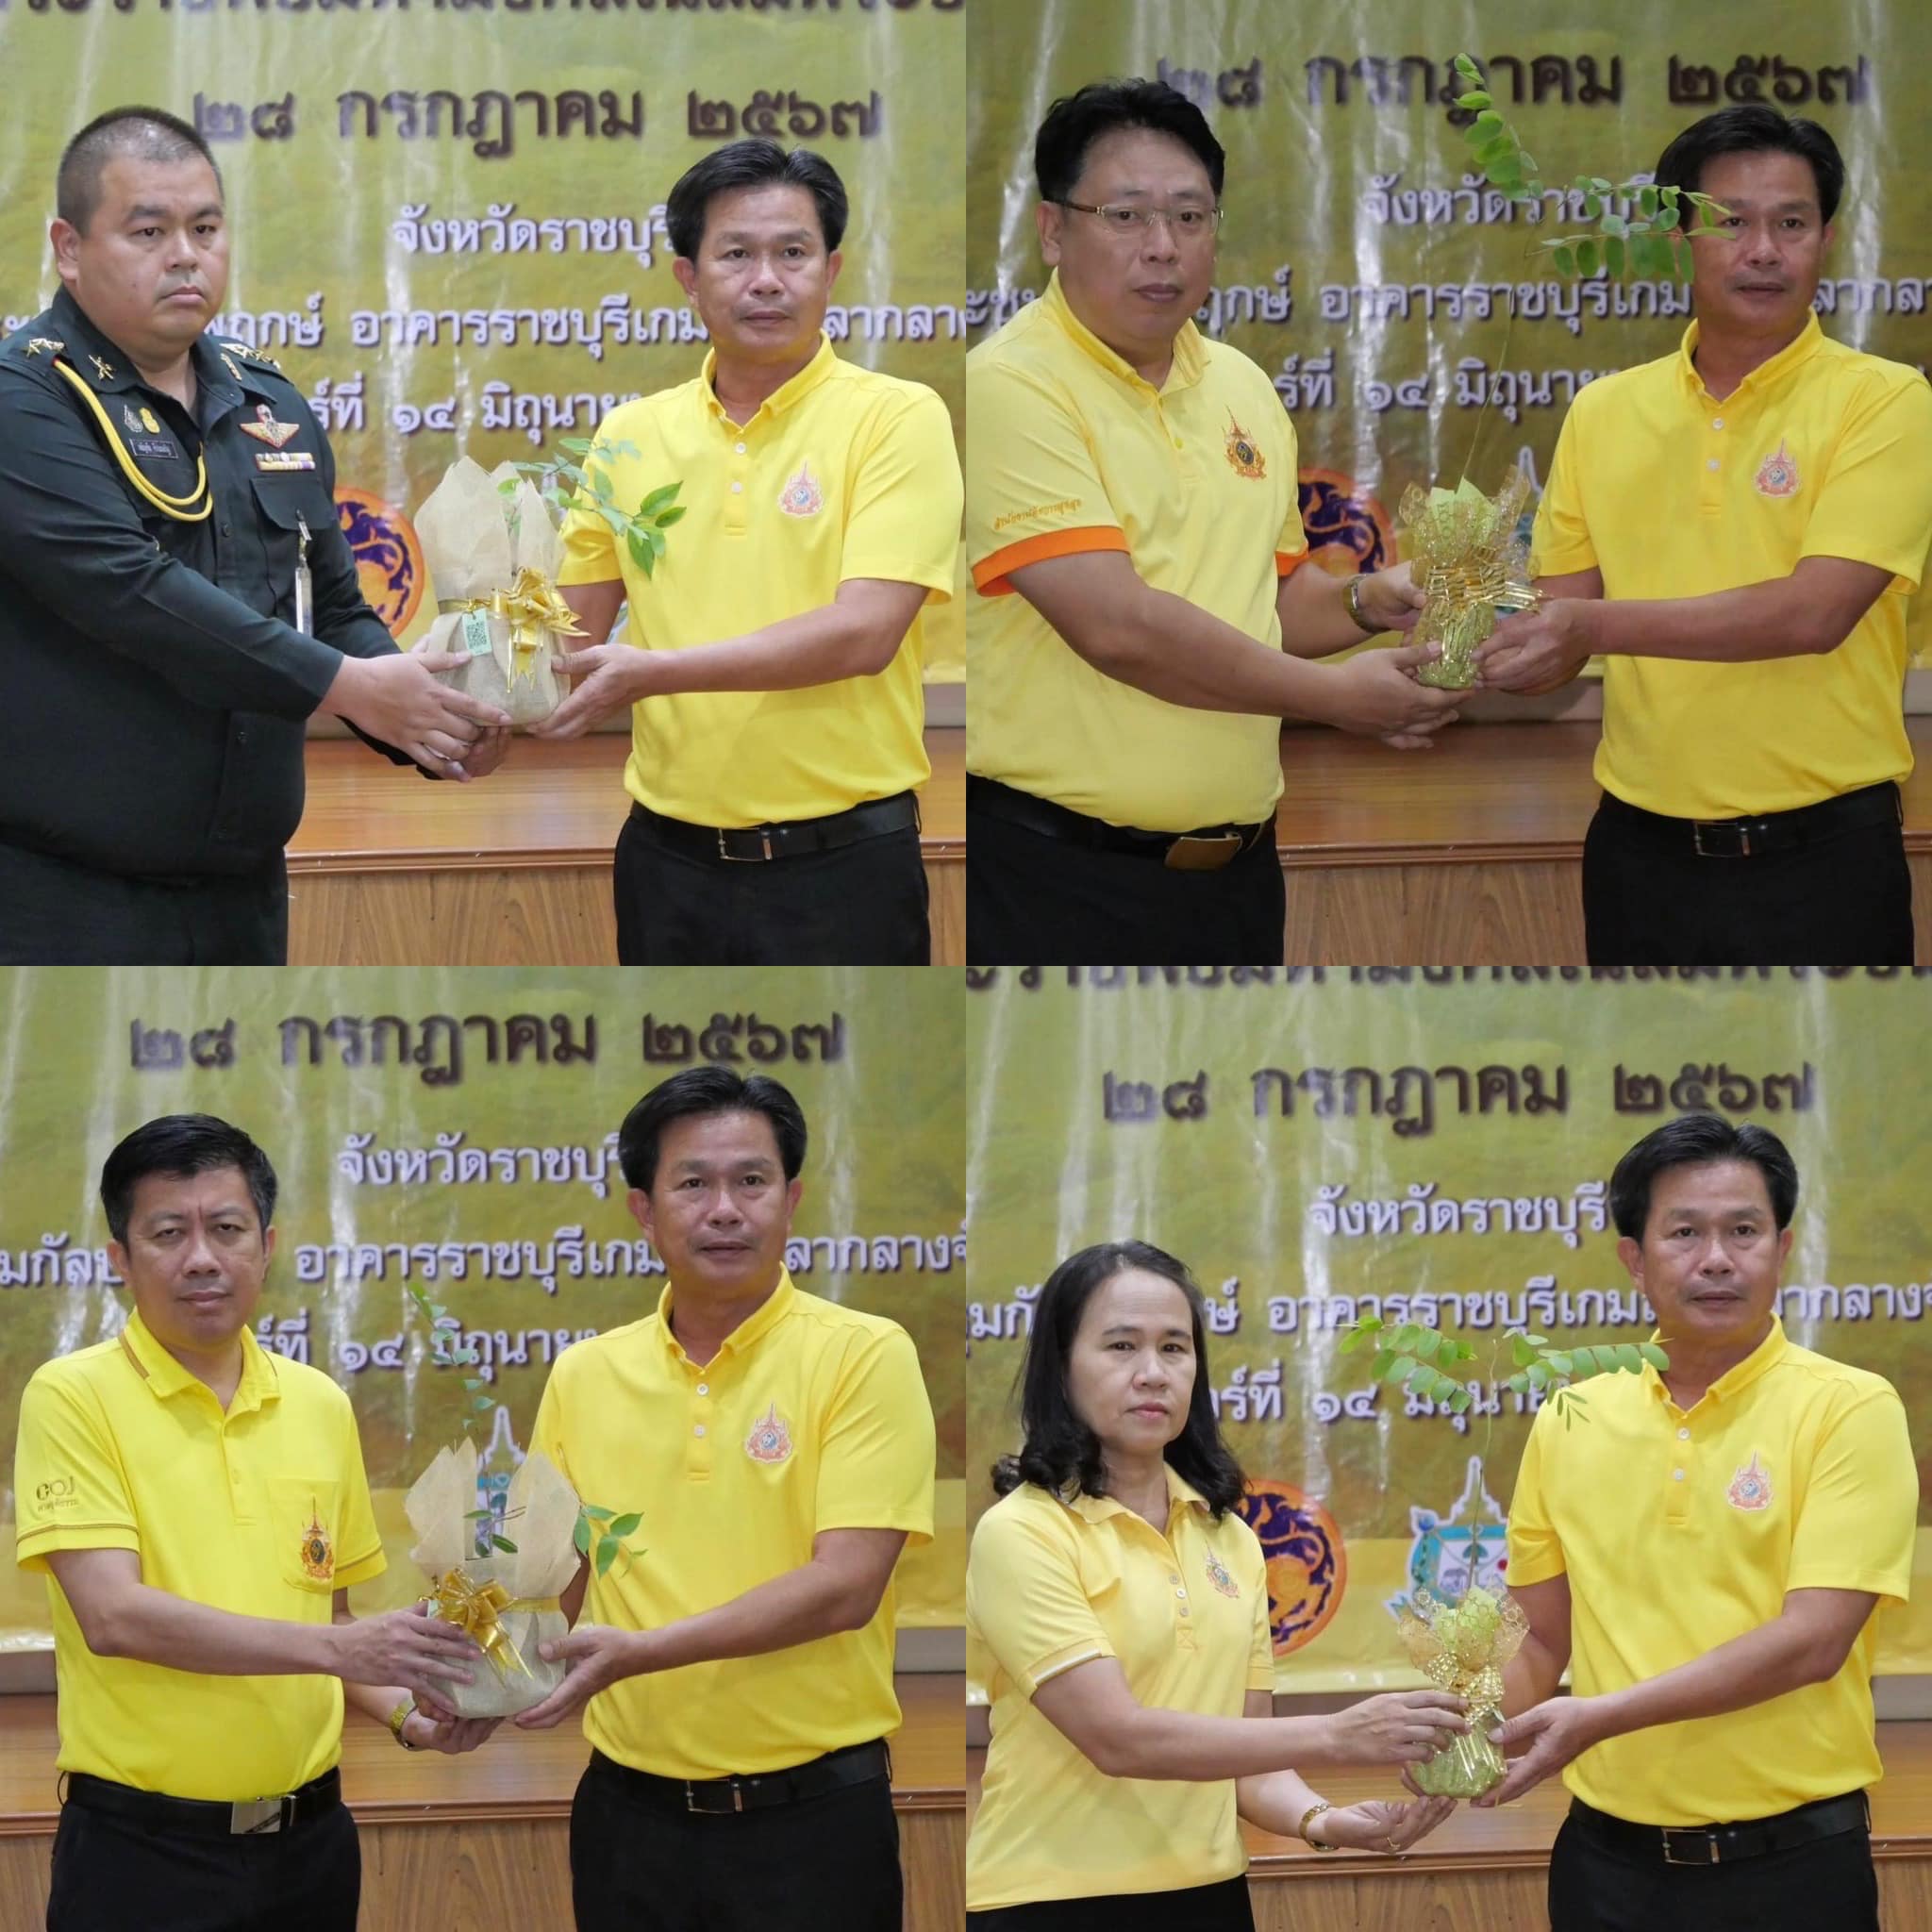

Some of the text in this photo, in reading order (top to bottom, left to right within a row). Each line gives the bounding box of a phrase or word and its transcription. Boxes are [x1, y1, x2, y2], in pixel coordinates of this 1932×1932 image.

[1668, 53, 1870, 106] ๒๕๖๗
[337, 90, 642, 157] กรกฎาคม
[688, 90, 880, 140] ๒๕๖๗
[130, 1011, 844, 1088] ๒๘ กรกฎาคม ๒๕๖๗
[1102, 1060, 1815, 1138] ๒๘ กรกฎาคม ๒๕๖๗
